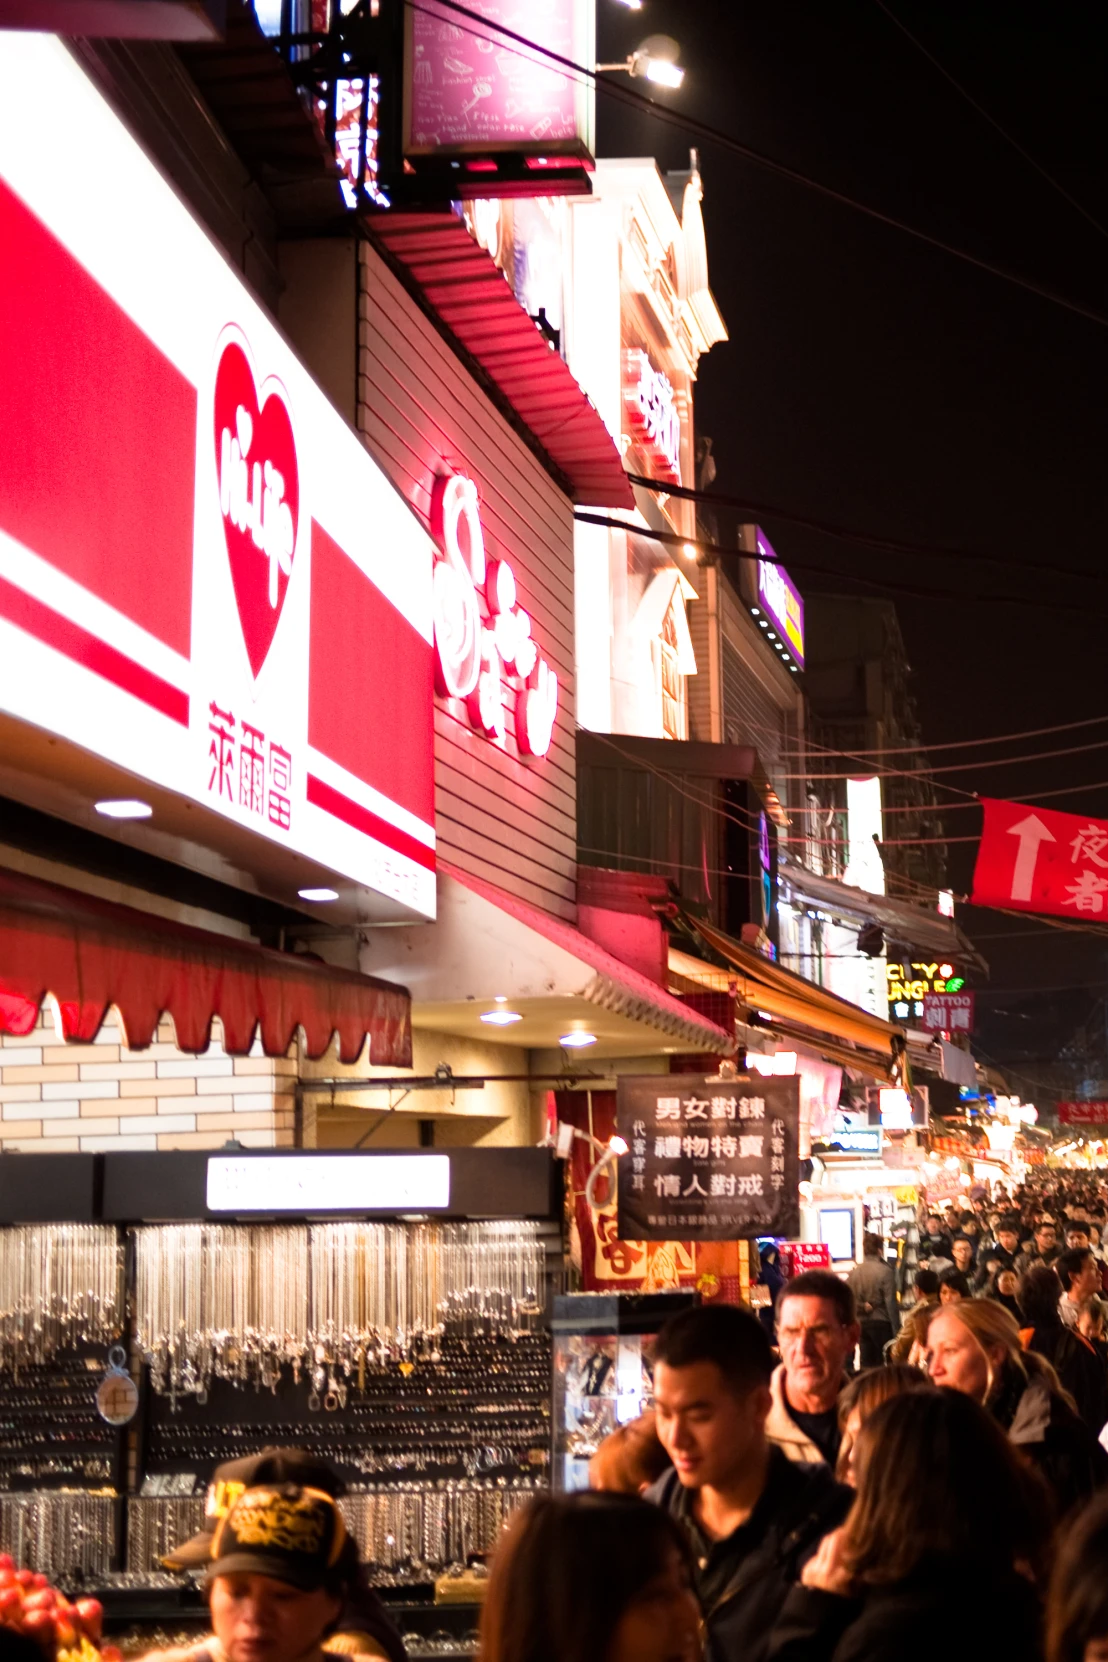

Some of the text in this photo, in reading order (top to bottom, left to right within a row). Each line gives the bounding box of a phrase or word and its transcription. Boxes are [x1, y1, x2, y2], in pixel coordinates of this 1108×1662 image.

[208, 700, 292, 831] 萊爾富
[886, 962, 938, 980] CIY
[925, 995, 971, 1007] TATTOO
[925, 1007, 970, 1029] 刺青
[655, 1096, 765, 1120] 男女對鍊
[654, 1135, 764, 1158] 禮物特賣
[770, 1118, 785, 1192] 代客刻字
[653, 1173, 764, 1197] 情人對戒
